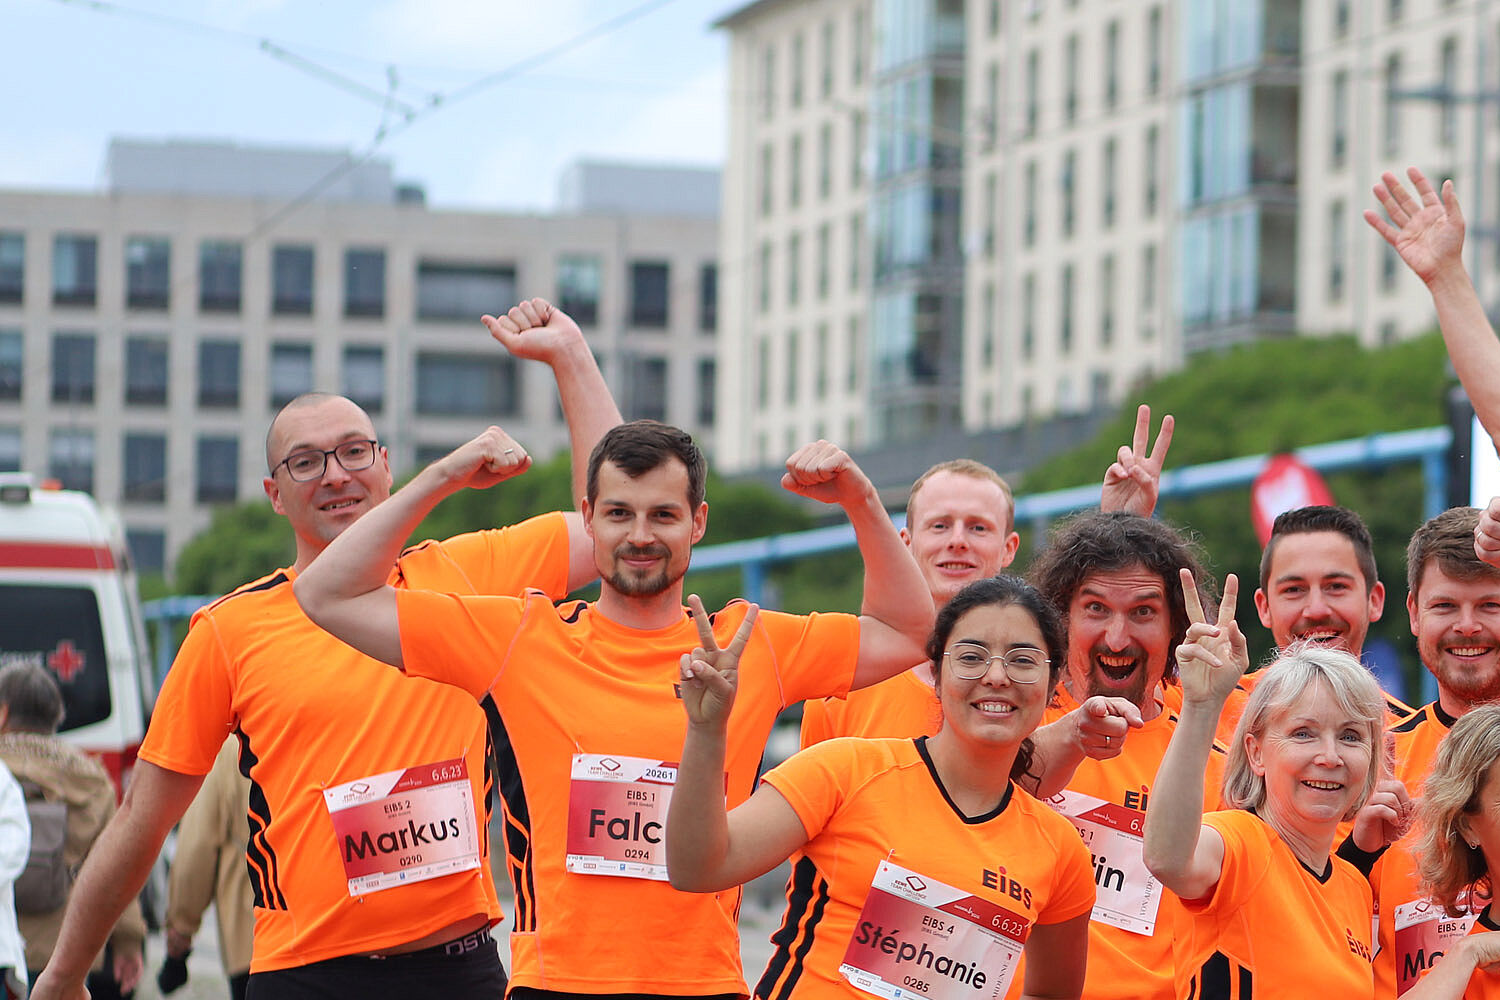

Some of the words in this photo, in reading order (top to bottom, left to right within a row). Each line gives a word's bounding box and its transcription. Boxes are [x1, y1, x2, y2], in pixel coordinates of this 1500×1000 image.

[432, 765, 462, 780] 6.6.23
[645, 768, 674, 780] 20261
[627, 790, 647, 801] EIBS
[651, 793, 655, 802] 1
[1124, 785, 1148, 811] Ei
[384, 803, 403, 814] EIBS
[405, 800, 411, 809] 2
[345, 818, 460, 862] Markus
[399, 854, 423, 866] 0290
[625, 849, 649, 860] 0294
[922, 915, 944, 931] EIBS
[946, 925, 955, 935] 4
[992, 914, 1023, 937] 6.6.23
[1437, 922, 1457, 934] EIBS
[1460, 922, 1466, 931] 4
[855, 921, 987, 990] Stéphanie
[903, 975, 930, 993] 0285
